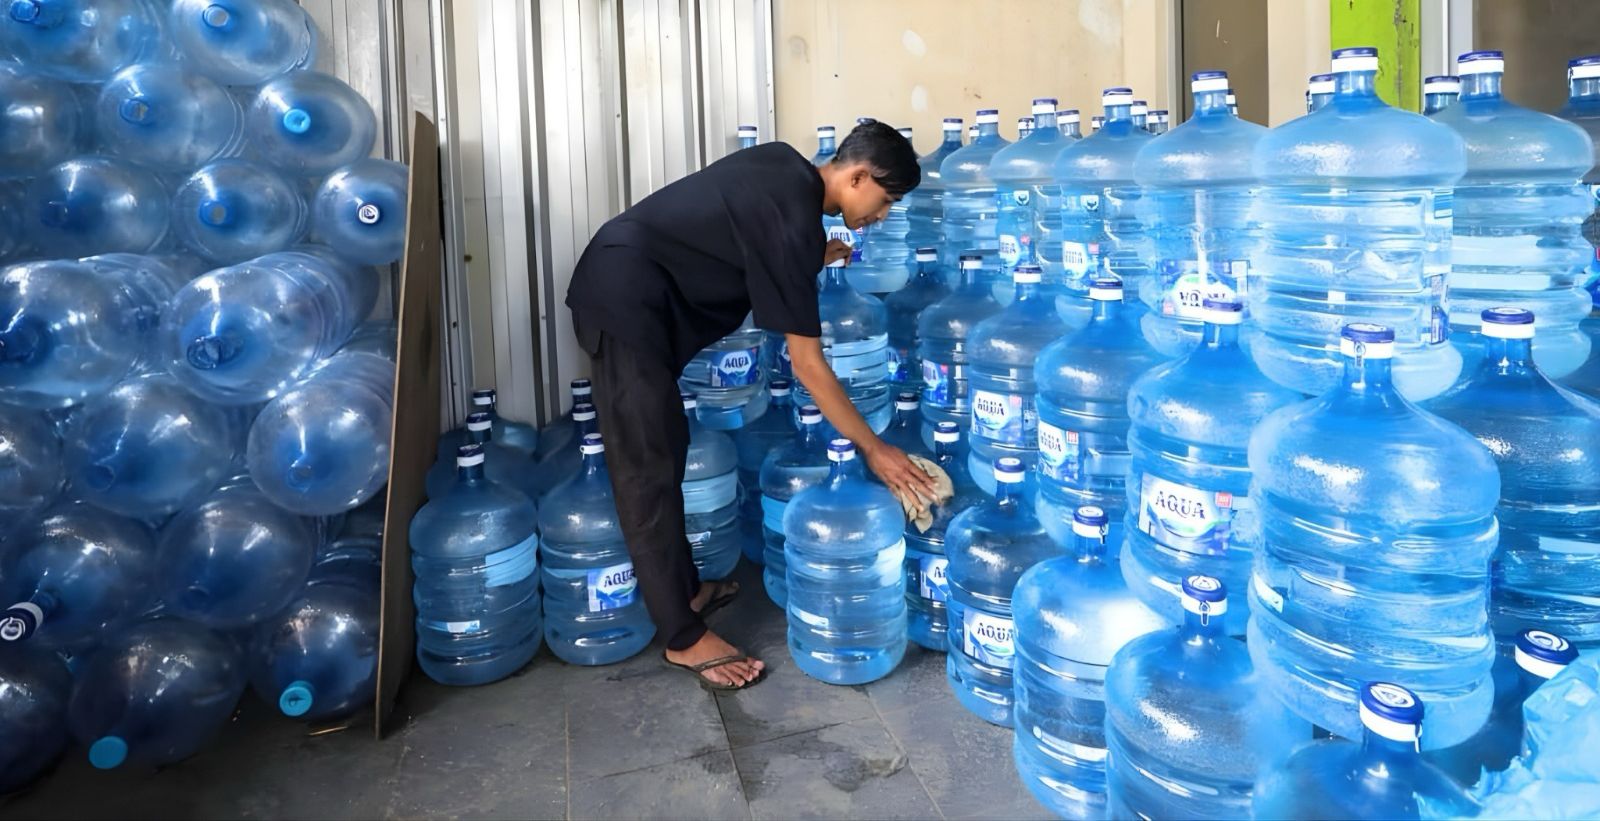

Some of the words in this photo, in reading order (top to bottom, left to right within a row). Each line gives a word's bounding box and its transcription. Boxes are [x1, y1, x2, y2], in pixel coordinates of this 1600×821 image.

[724, 356, 750, 369] AQUA
[977, 397, 1005, 417] AQUA
[1155, 491, 1206, 519] AQUA
